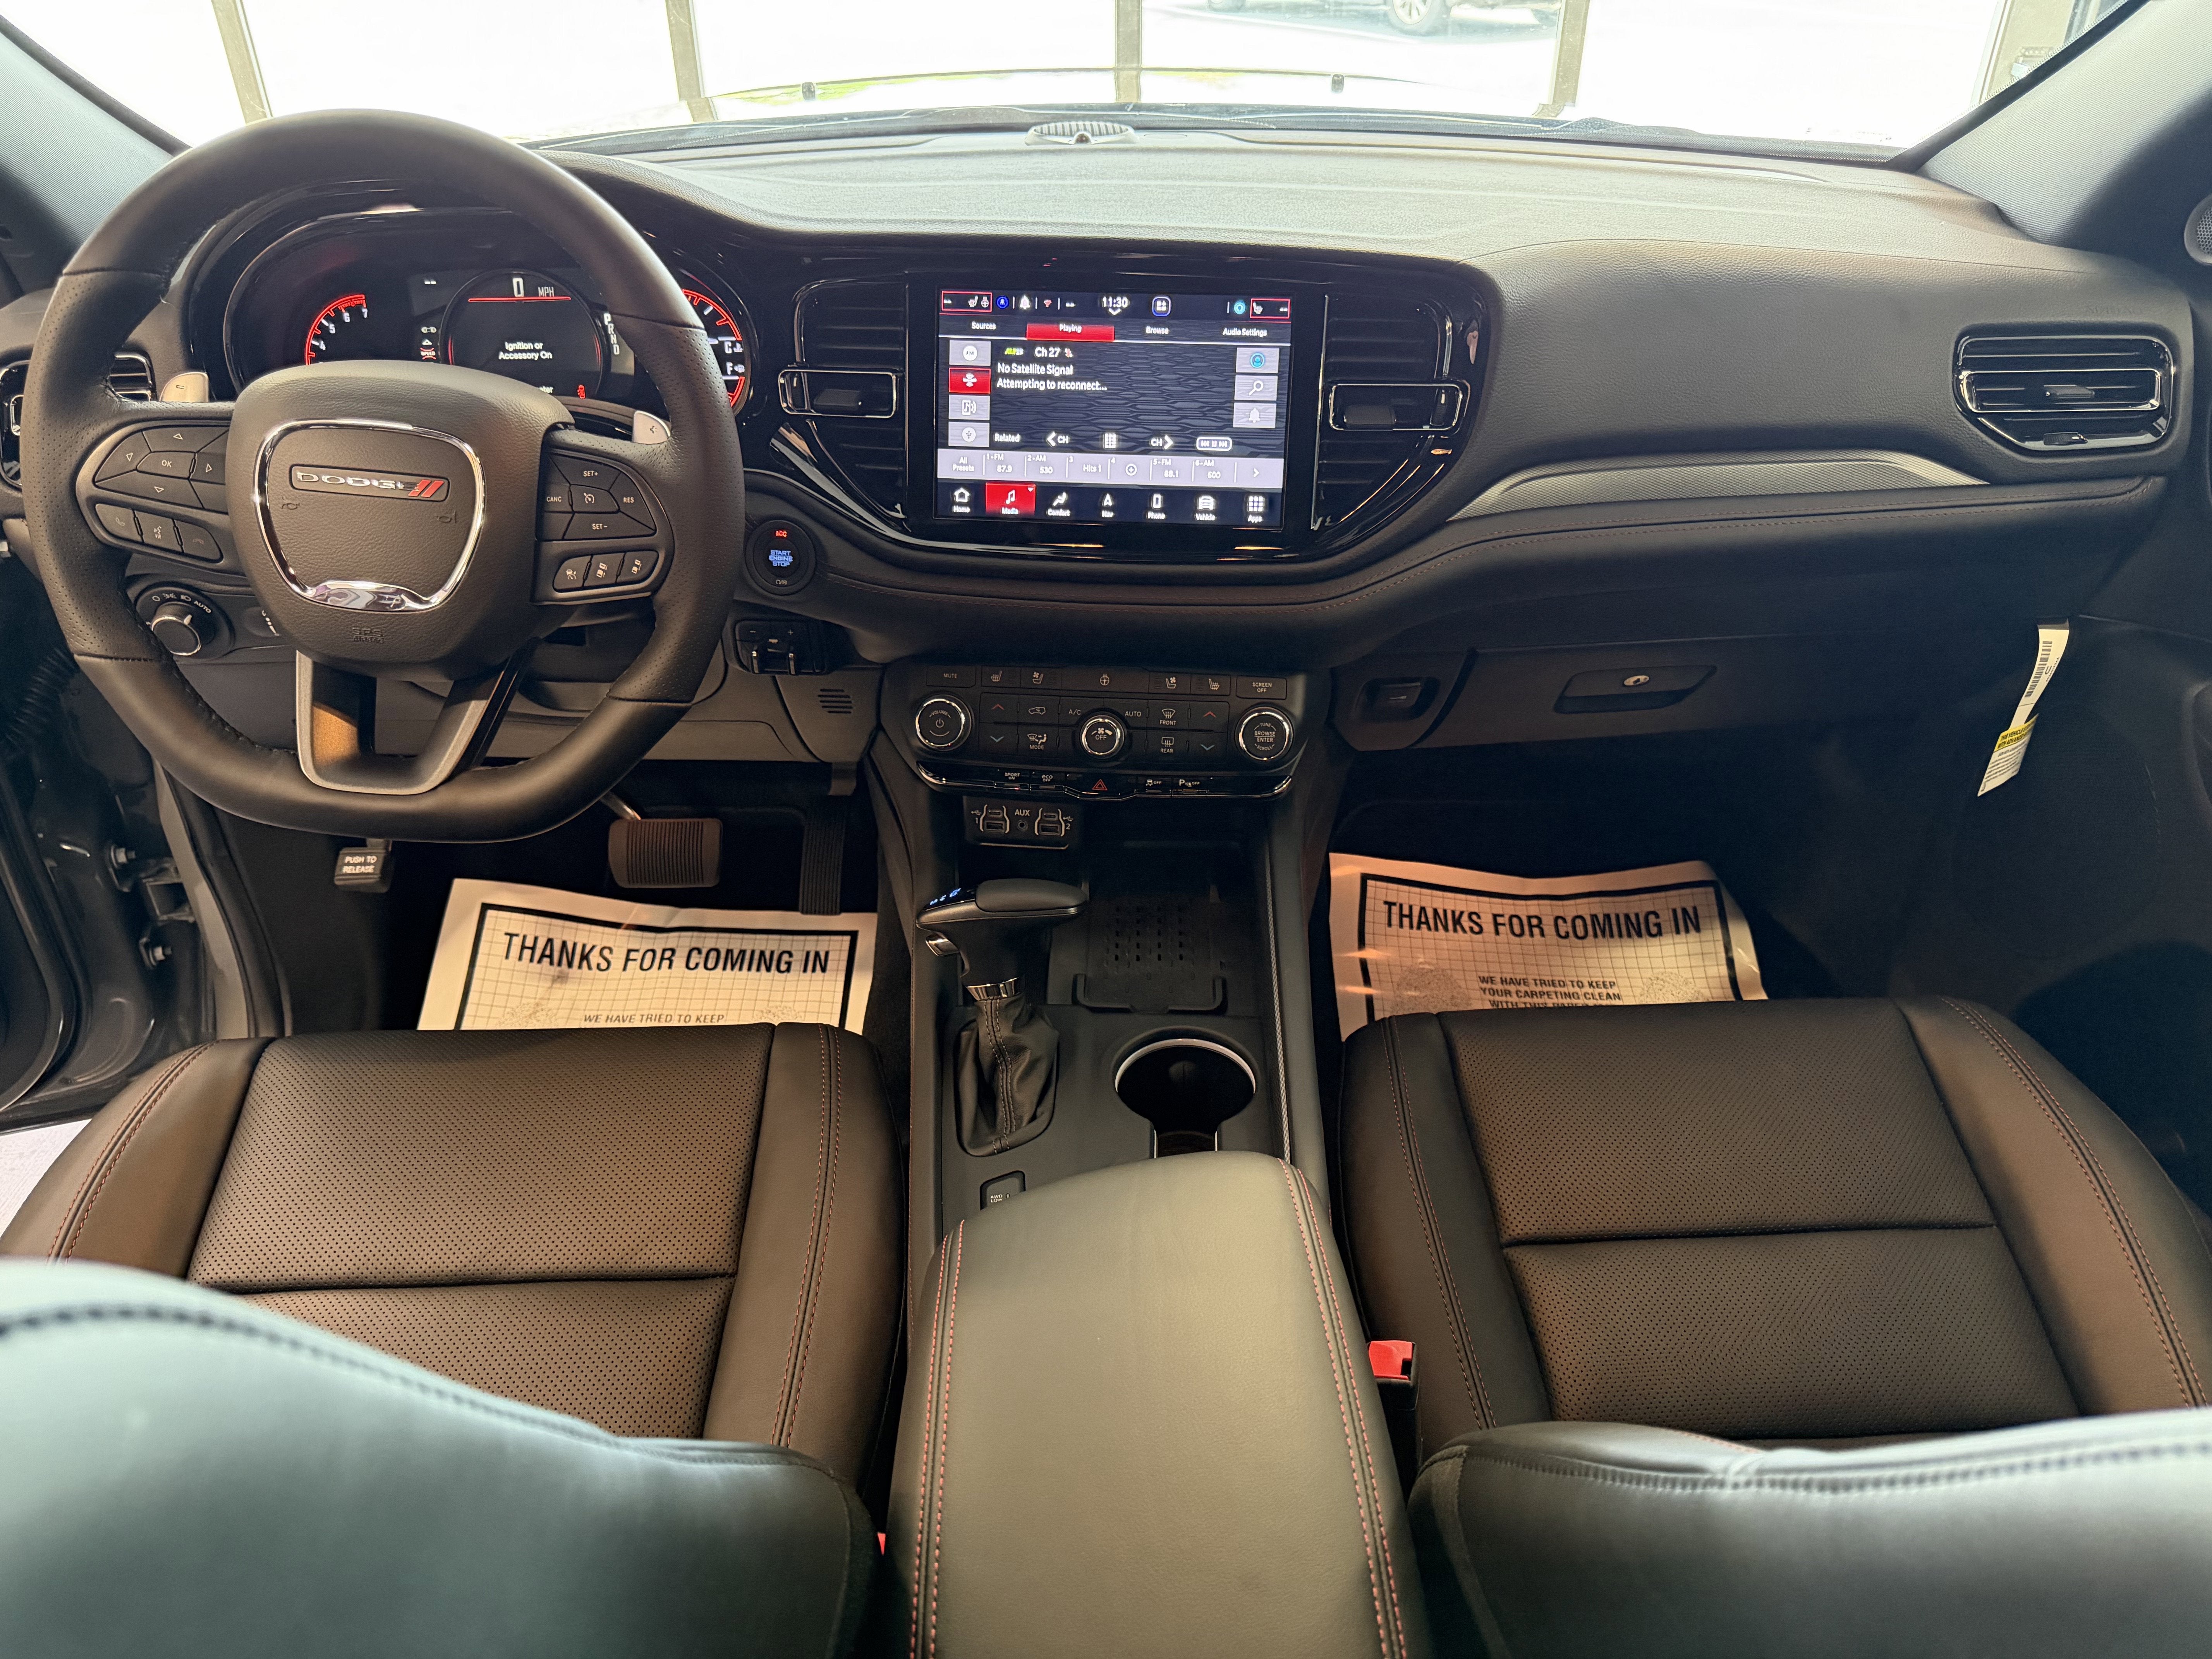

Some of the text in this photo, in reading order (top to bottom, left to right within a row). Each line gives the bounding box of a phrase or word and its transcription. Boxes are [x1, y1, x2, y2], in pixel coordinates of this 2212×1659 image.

[513, 278, 555, 297] 0 MPH
[1103, 297, 1128, 307] 11:30
[343, 313, 350, 323] 6
[362, 308, 368, 318] 7
[329, 324, 336, 334] 5
[972, 321, 996, 330] Sources
[1059, 324, 1082, 333] Playing
[1146, 326, 1169, 334] Browse
[1223, 328, 1267, 337] Audio Settings
[319, 341, 326, 350] 4
[505, 342, 533, 350] Ignition
[724, 342, 732, 354] C
[499, 351, 552, 361] Accessory On
[1035, 347, 1047, 357] Ch
[1049, 347, 1061, 357] 27
[726, 362, 733, 375] F
[998, 363, 1073, 377] No Satellite Signal
[997, 378, 1045, 391] Attempting
[1047, 380, 1056, 389] to
[994, 433, 1020, 442] Related
[1057, 436, 1069, 444] CH
[1151, 438, 1162, 446] CH
[297, 471, 419, 491] DODGE
[953, 505, 970, 514] Home
[1048, 508, 1071, 517] Comfort
[1195, 513, 1216, 521] Vehicle
[1248, 515, 1263, 523] Apps
[194, 601, 211, 613] AUTO
[343, 865, 375, 874] RELEASE
[1383, 900, 1701, 940] THANKS FOR COMING IN
[504, 932, 830, 974] THANKS FOR COMING IN
[1478, 975, 1616, 989] WE HAVE TRIED TO KEEP
[1480, 987, 1621, 1001] YOUR CARPETING CLEAN
[1489, 1000, 1518, 1008] WITH
[584, 1014, 725, 1024] WE HAVE TRIED TO KEEP
